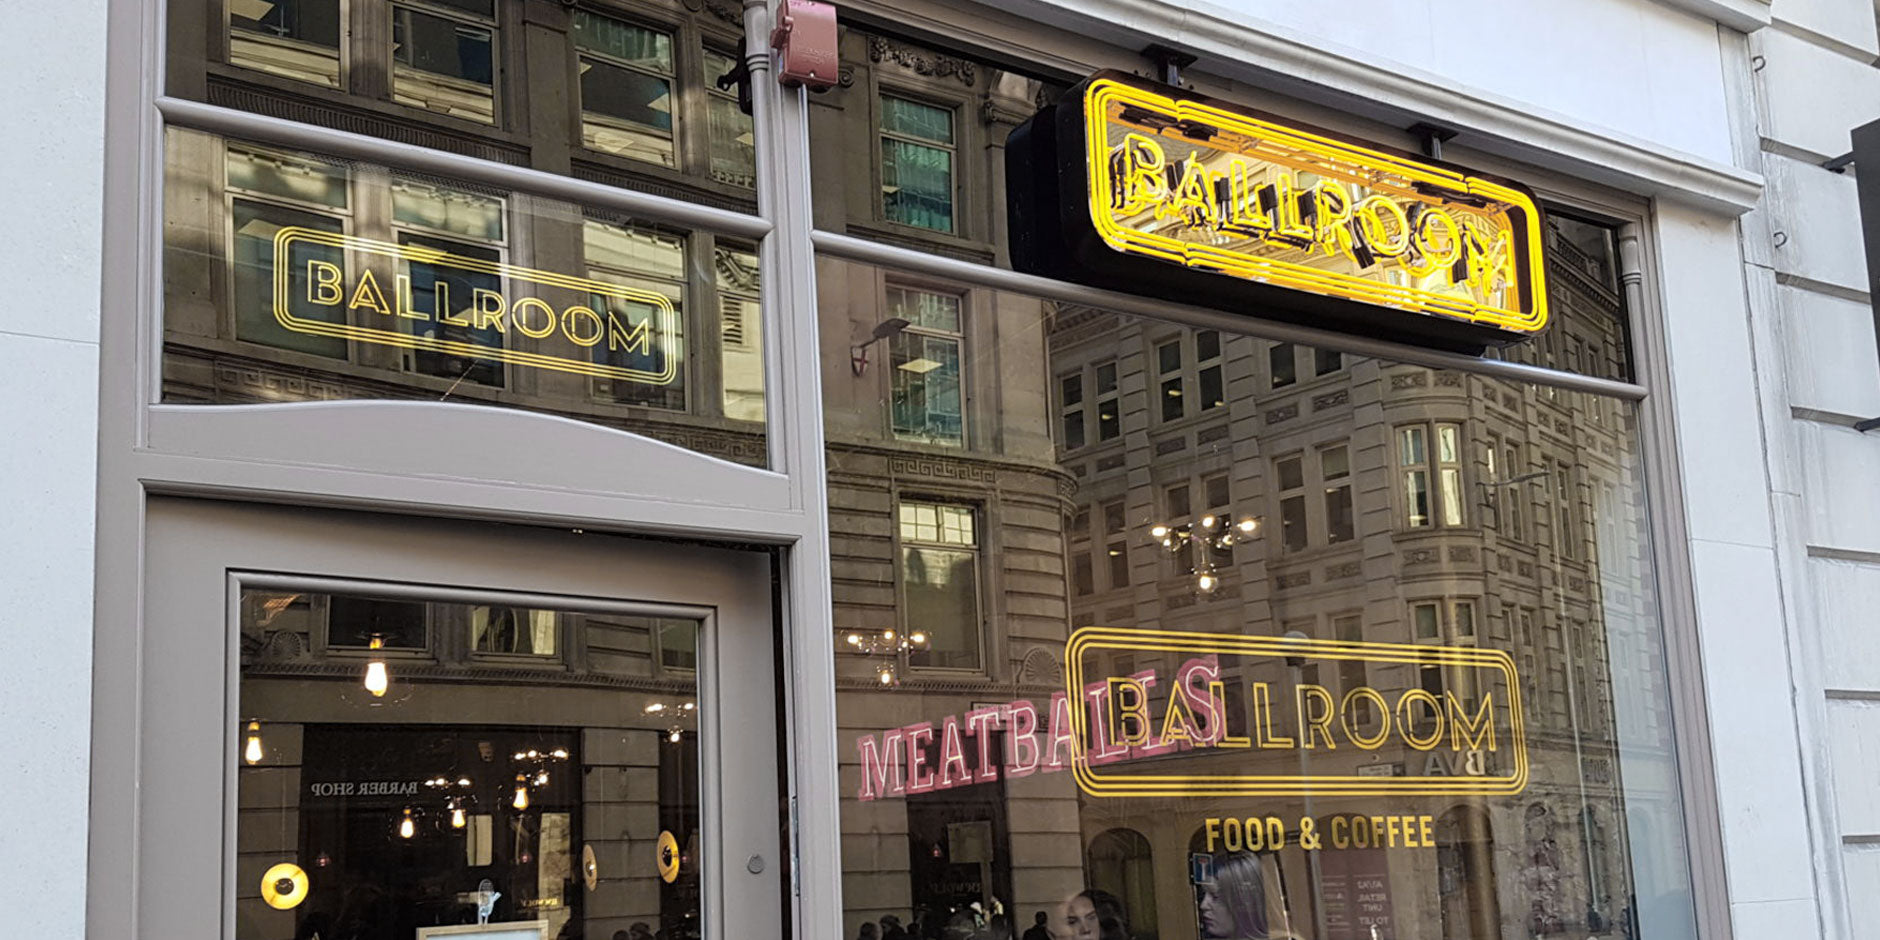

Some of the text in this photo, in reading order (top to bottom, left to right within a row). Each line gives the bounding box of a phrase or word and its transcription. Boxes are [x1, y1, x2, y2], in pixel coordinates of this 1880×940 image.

[1124, 132, 1516, 296] BALLROOM
[306, 258, 650, 357] BALLROOM
[856, 654, 1224, 801] MEATBALLS
[1106, 676, 1497, 753] BALLROOM
[1205, 815, 1435, 853] FOOD & COFFEE
